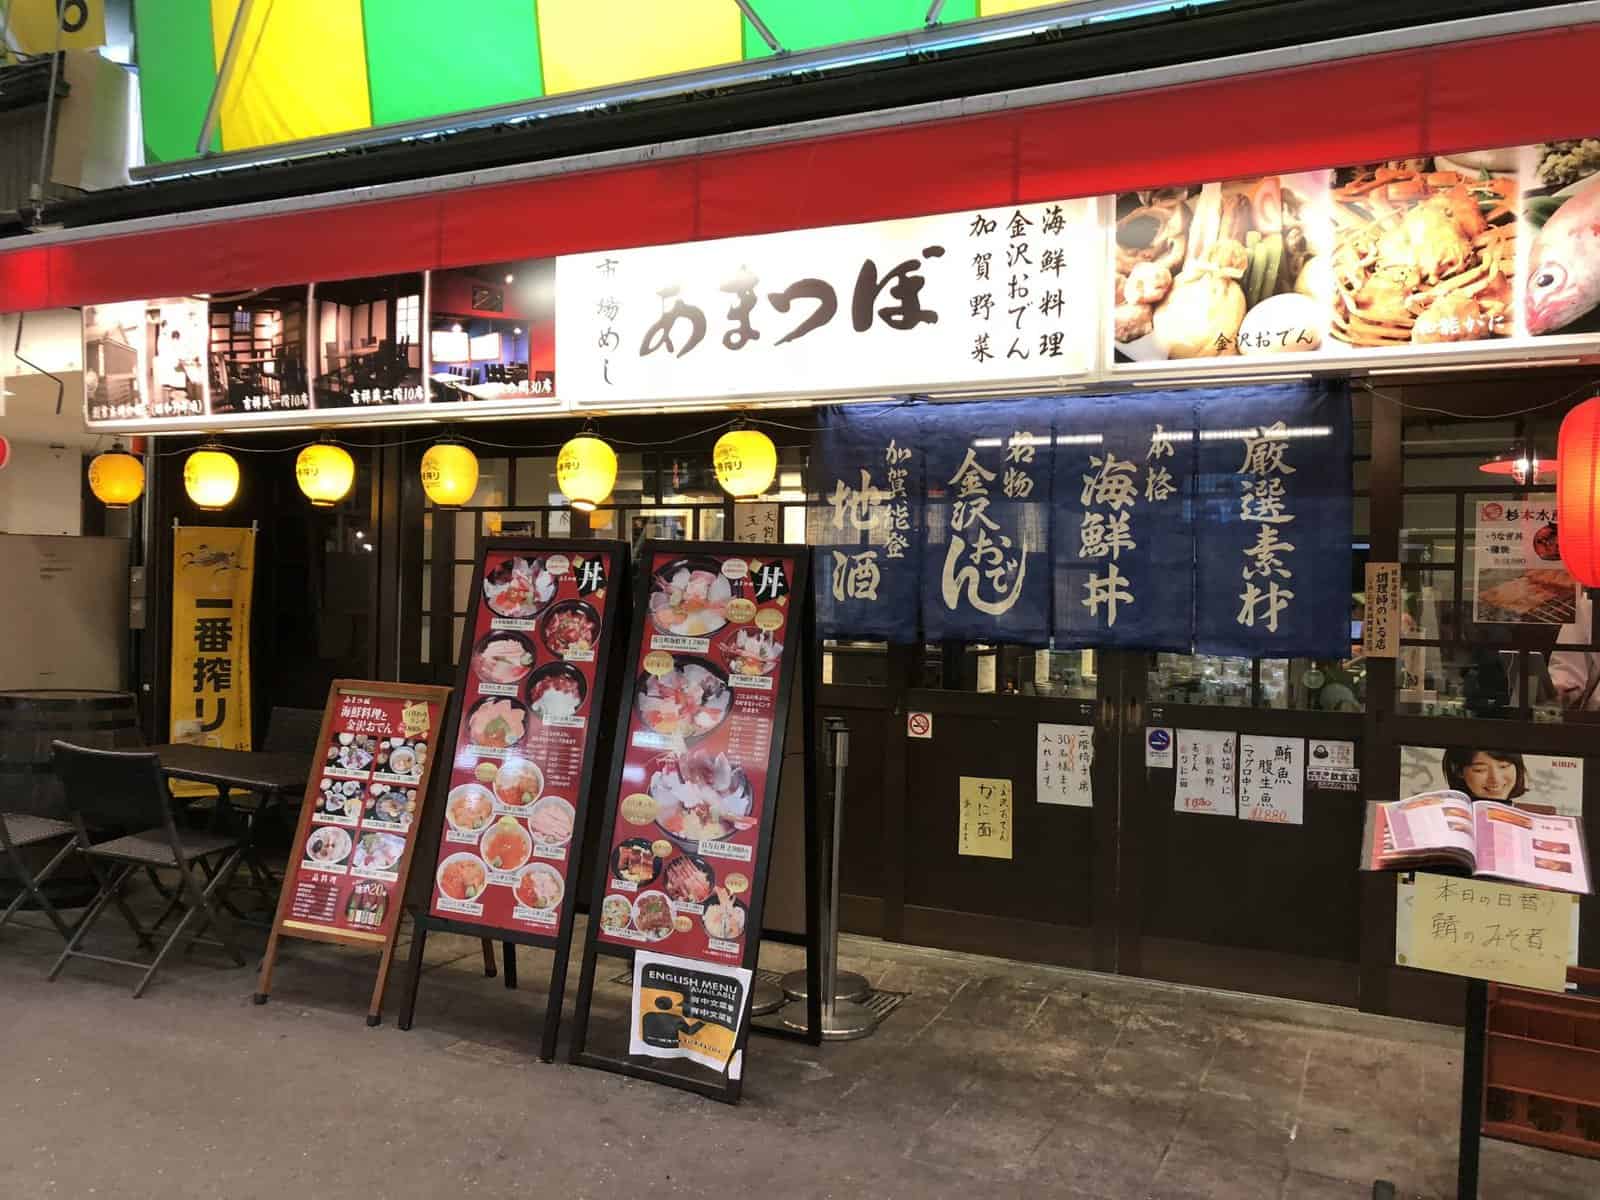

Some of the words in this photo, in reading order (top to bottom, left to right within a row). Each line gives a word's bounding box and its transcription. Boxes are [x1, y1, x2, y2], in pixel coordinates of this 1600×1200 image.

[595, 257, 620, 386] 市場めし
[639, 245, 946, 359] あまつぼ
[969, 213, 997, 364] 加賀野菜
[1006, 208, 1034, 360] 金沢おでん
[1039, 203, 1067, 358] 海鮮料理
[1213, 327, 1315, 351] 金沢おでん
[1003, 430, 1036, 499] 名物
[1145, 423, 1178, 502] 本格
[1235, 420, 1297, 633] 厳選素材
[576, 559, 603, 592] 丼
[755, 566, 785, 599] 丼
[828, 469, 882, 602] 地酒
[942, 447, 1028, 616] 金沢おでん
[1078, 452, 1139, 628] 海鮮丼
[193, 598, 234, 733] 一番搾り
[648, 970, 698, 987] ENGLISH
[701, 979, 737, 994] MENU
[690, 985, 735, 1001] AVAILABLE
